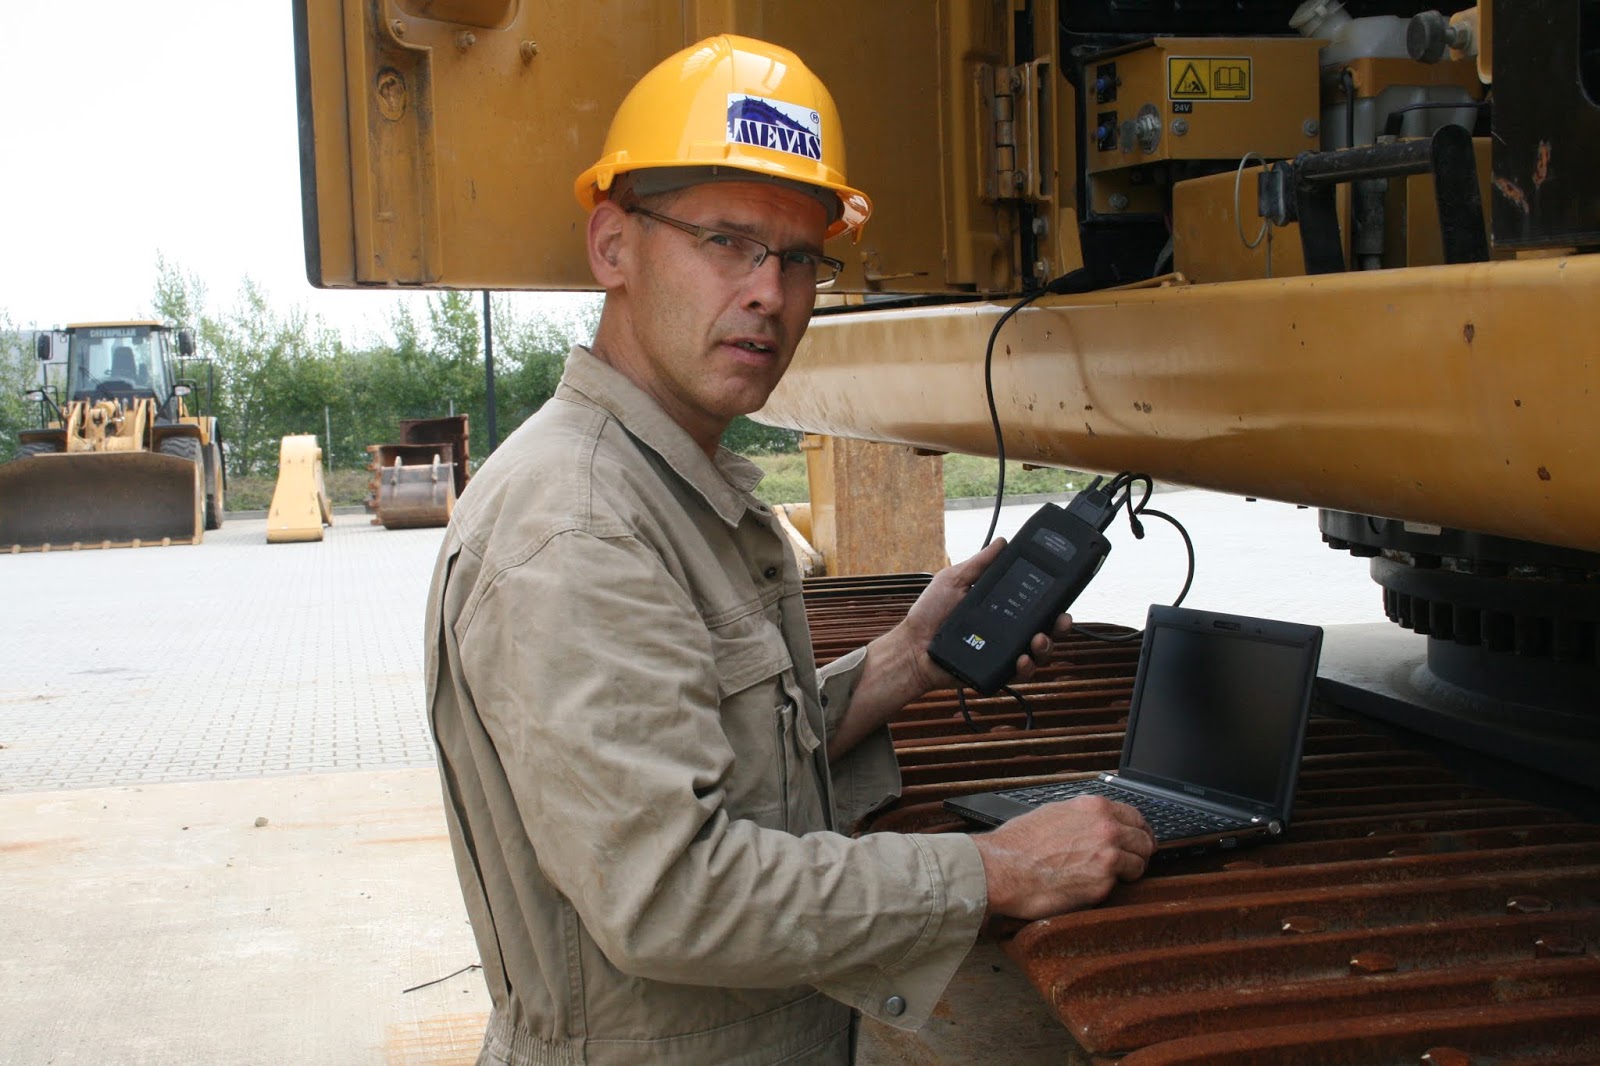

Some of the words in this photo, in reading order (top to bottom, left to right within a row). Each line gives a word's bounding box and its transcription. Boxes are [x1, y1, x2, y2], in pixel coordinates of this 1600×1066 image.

[1174, 104, 1190, 112] 24V
[735, 119, 821, 160] MEVAS
[90, 328, 137, 338] CATERPILLAR
[965, 633, 987, 651] CAT
